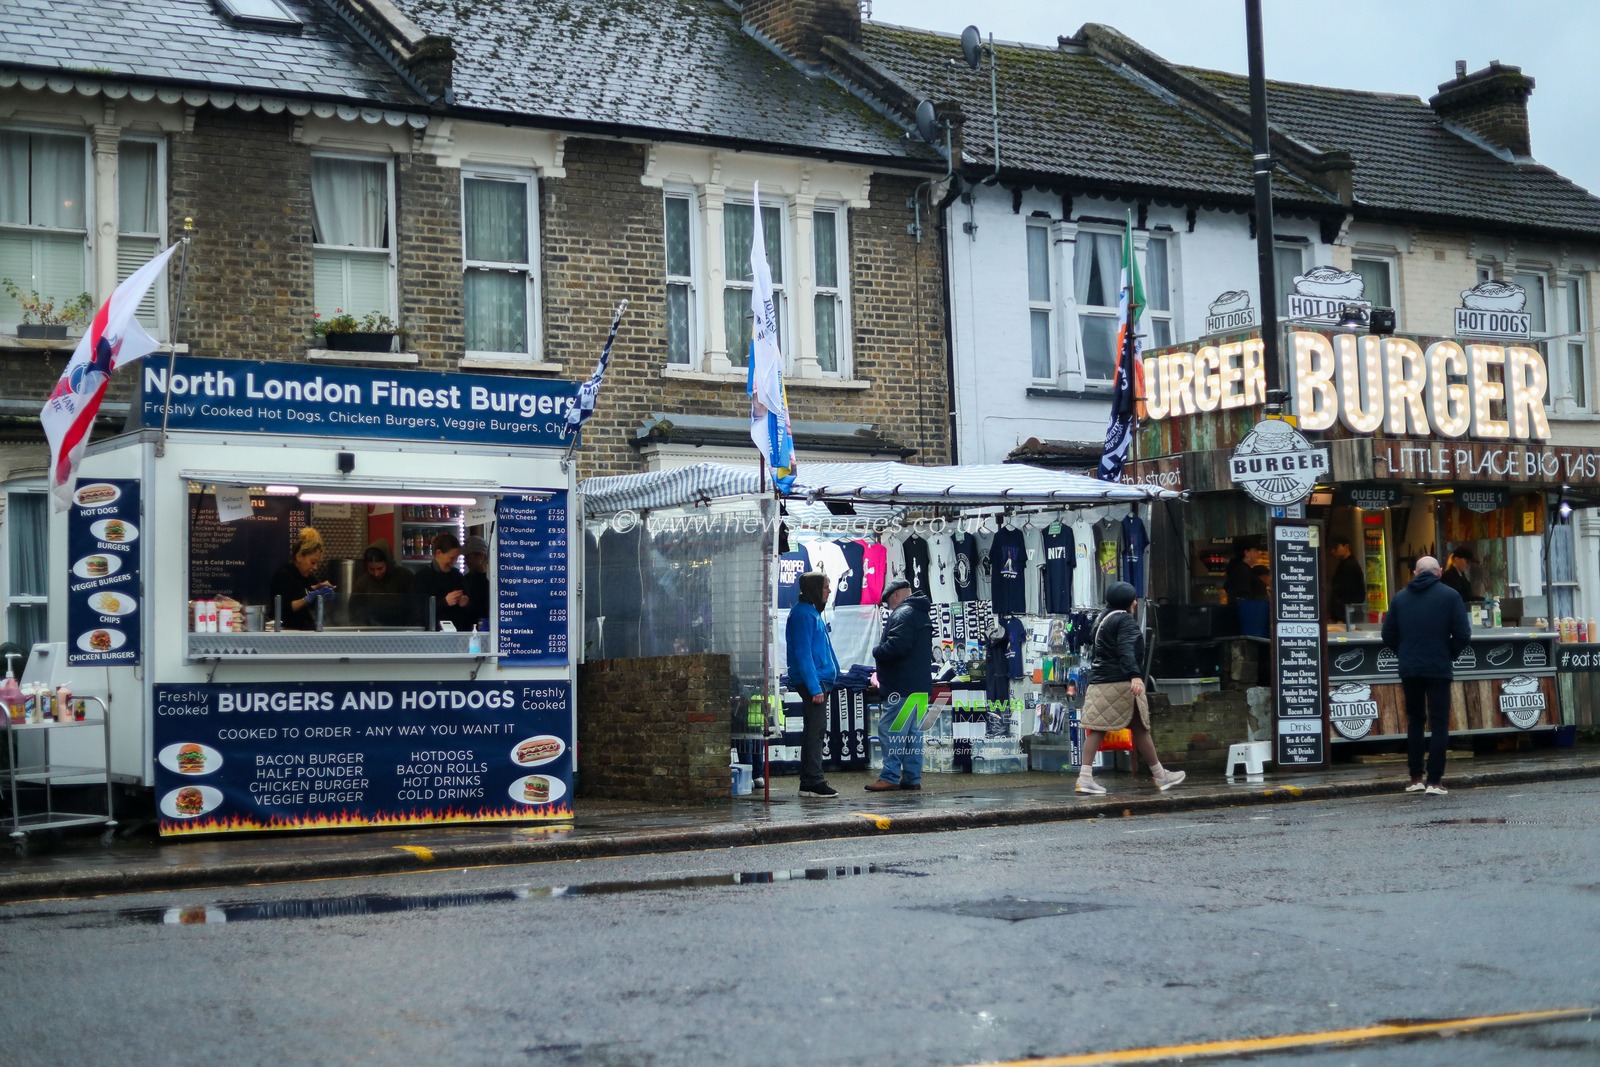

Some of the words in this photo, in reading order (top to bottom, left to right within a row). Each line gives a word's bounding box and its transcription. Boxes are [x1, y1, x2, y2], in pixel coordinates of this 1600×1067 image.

[1291, 297, 1323, 319] HOT
[1207, 316, 1226, 331] HOT
[1227, 311, 1254, 327] DOGS
[1458, 311, 1487, 331] HOT
[1489, 314, 1528, 333] DOGS
[1289, 331, 1551, 440] BURGER
[145, 367, 235, 397] North
[246, 373, 361, 404] London
[371, 381, 461, 409] Finest
[471, 387, 576, 418] Burgers
[144, 402, 195, 417] Freshly
[201, 405, 253, 418] Cooked
[258, 408, 281, 419] Hot
[287, 410, 324, 423] Dogs,
[329, 411, 381, 425] Chicken
[386, 414, 439, 429] Burgers,
[443, 417, 486, 431] Veggie
[490, 420, 541, 433] Burgers,
[1234, 454, 1324, 474] BURGER
[1388, 447, 1450, 474] LITTLE
[1455, 449, 1519, 476] PLACE
[1525, 452, 1559, 477] BIG
[1255, 482, 1307, 501] KITCHEN
[1351, 490, 1386, 500] QUEUE
[1389, 490, 1395, 500] 2
[1463, 492, 1495, 502] QUEUE
[1498, 492, 1502, 502] 1
[80, 509, 97, 517] HOT
[97, 506, 118, 515] DOGS
[97, 542, 130, 552] BURGERS
[1048, 547, 1064, 560] N17
[1288, 543, 1304, 551] Burger
[1298, 554, 1314, 562] Burger
[780, 560, 804, 572] PROPER
[71, 579, 98, 592] VEGGIE
[98, 573, 131, 586] BURGERS
[1298, 592, 1314, 600] Burger
[99, 615, 121, 624] CHIPS
[1300, 611, 1315, 619] Burger
[1282, 626, 1295, 634] Hot
[1296, 626, 1316, 636] Dogs
[69, 652, 101, 662] CHICKEN
[102, 651, 135, 660] BURGERS
[1561, 652, 1570, 667] #
[1572, 652, 1590, 667] eat
[158, 691, 209, 704] Freshly
[523, 687, 566, 699] Freshly
[217, 692, 334, 713] BURGERS
[340, 691, 394, 711] AND
[401, 690, 515, 710] HOTDOGS
[522, 699, 566, 710] Cooked
[1502, 696, 1518, 708] HOT
[1520, 694, 1544, 707] DOGS
[158, 705, 209, 716] Cooked
[1330, 704, 1347, 716] HOT
[1349, 703, 1376, 716] DOGS
[218, 728, 277, 740] COOKED
[282, 727, 300, 739] TO
[304, 726, 351, 738] ORDER
[365, 725, 393, 737] ANY
[397, 725, 426, 737] WAY
[430, 725, 458, 735] YOU
[462, 724, 500, 735] WANT
[504, 724, 515, 734] IT
[1290, 723, 1312, 732] Drinks
[256, 754, 304, 766] BACON
[309, 753, 364, 765] BURGER
[411, 750, 474, 762] HOTDOGS
[256, 768, 293, 779] HALF
[297, 766, 363, 778] POUNDER
[396, 764, 442, 776] BACON
[447, 762, 488, 773] ROLLS
[249, 781, 310, 793] CHICKEN
[314, 779, 369, 791] BURGER
[403, 777, 430, 788] HOT
[434, 775, 481, 787] DRINKS
[254, 794, 304, 806] VEGGIE
[309, 792, 364, 804] BURGER
[397, 789, 434, 801] COLD
[438, 788, 484, 799] DRINKS
